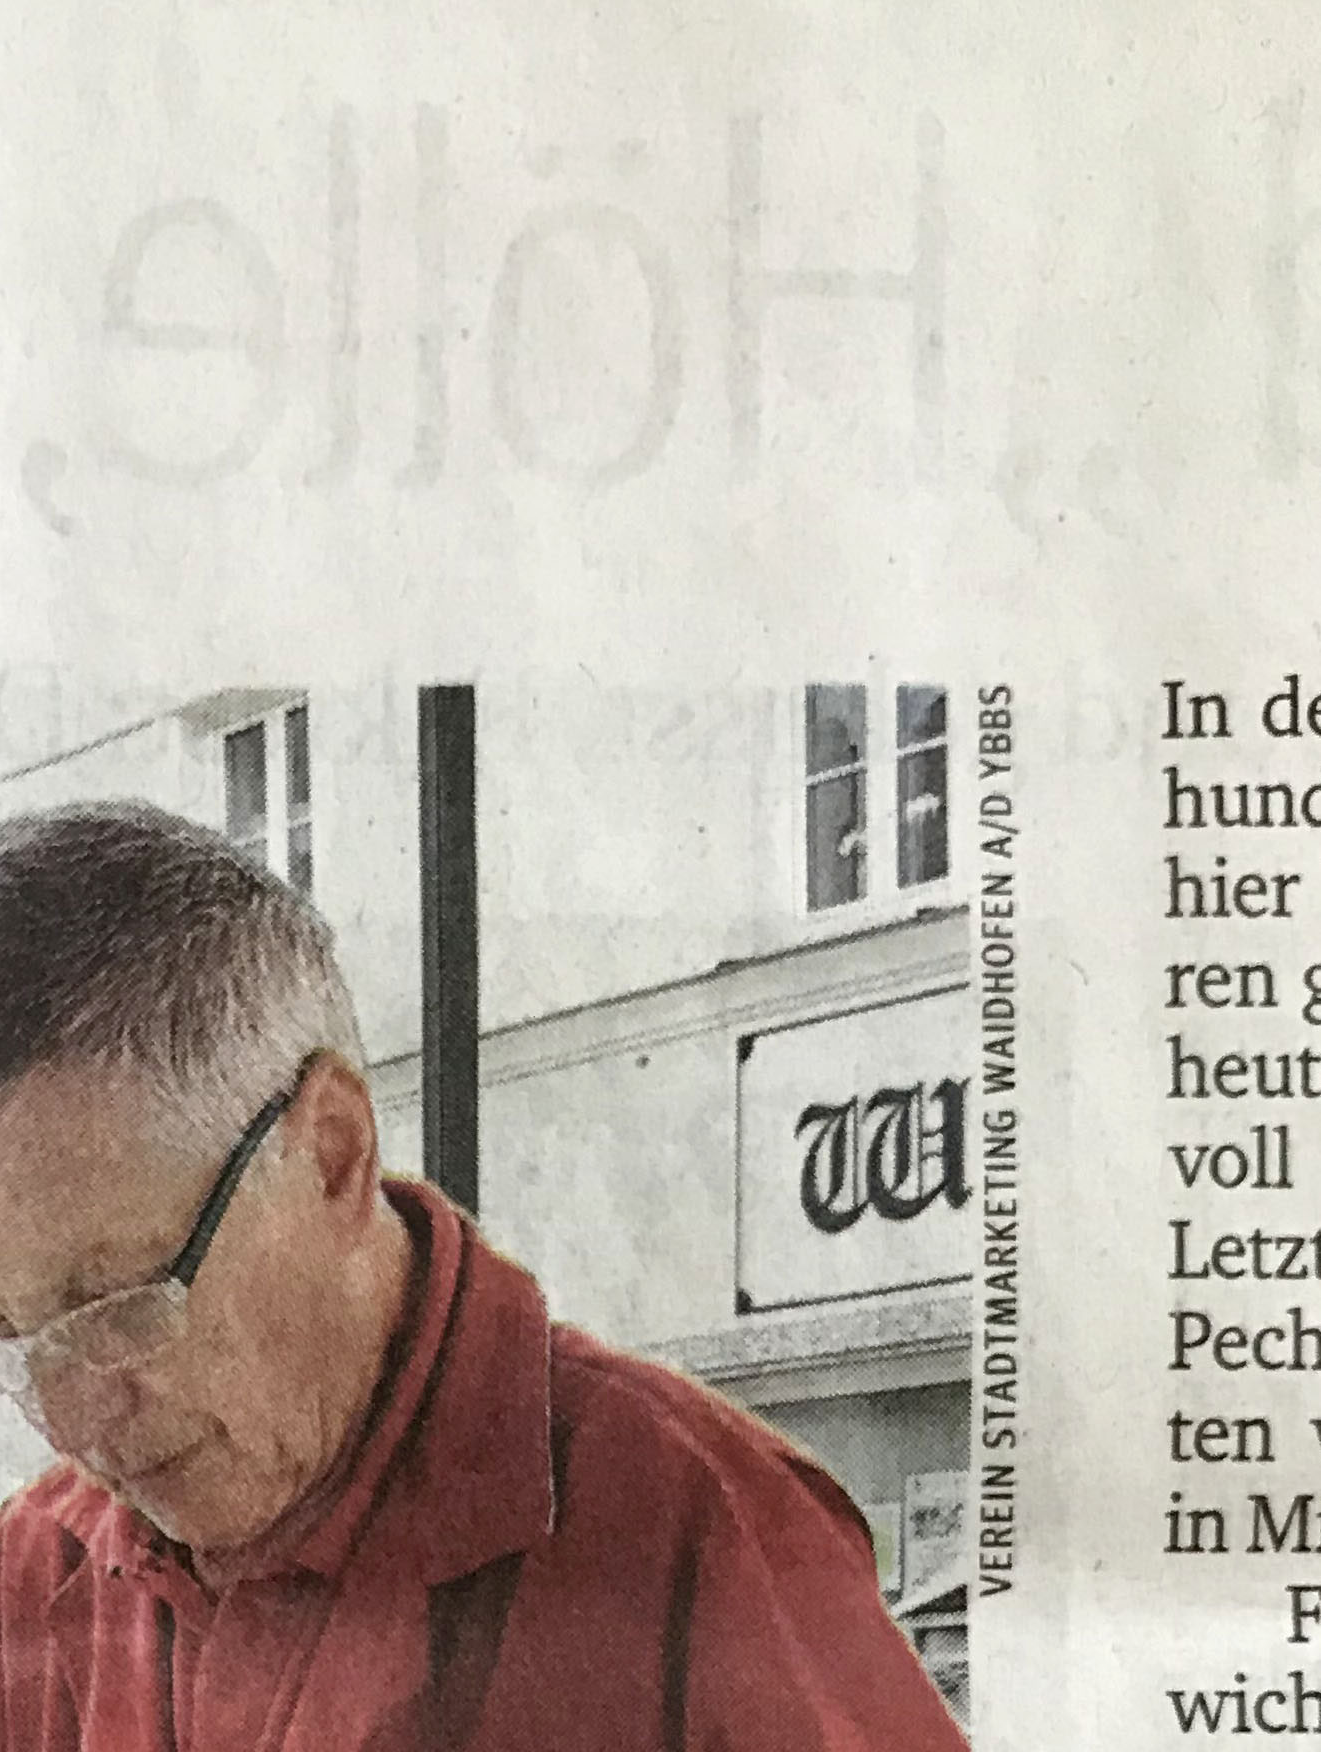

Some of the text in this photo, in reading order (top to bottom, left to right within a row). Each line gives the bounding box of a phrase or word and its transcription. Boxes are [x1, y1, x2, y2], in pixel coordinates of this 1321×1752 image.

[1161, 680, 1233, 740] In
[1163, 855, 1301, 919] hier
[1164, 962, 1280, 1009] ren
[978, 684, 1020, 1598] VEREIN STADTMARKETING WAIDHOFEN A/D YBBS
[1166, 1124, 1294, 1190] voll
[1167, 1306, 1321, 1372] Pech
[1166, 1410, 1276, 1464] ten
[1163, 1491, 1229, 1555] in
